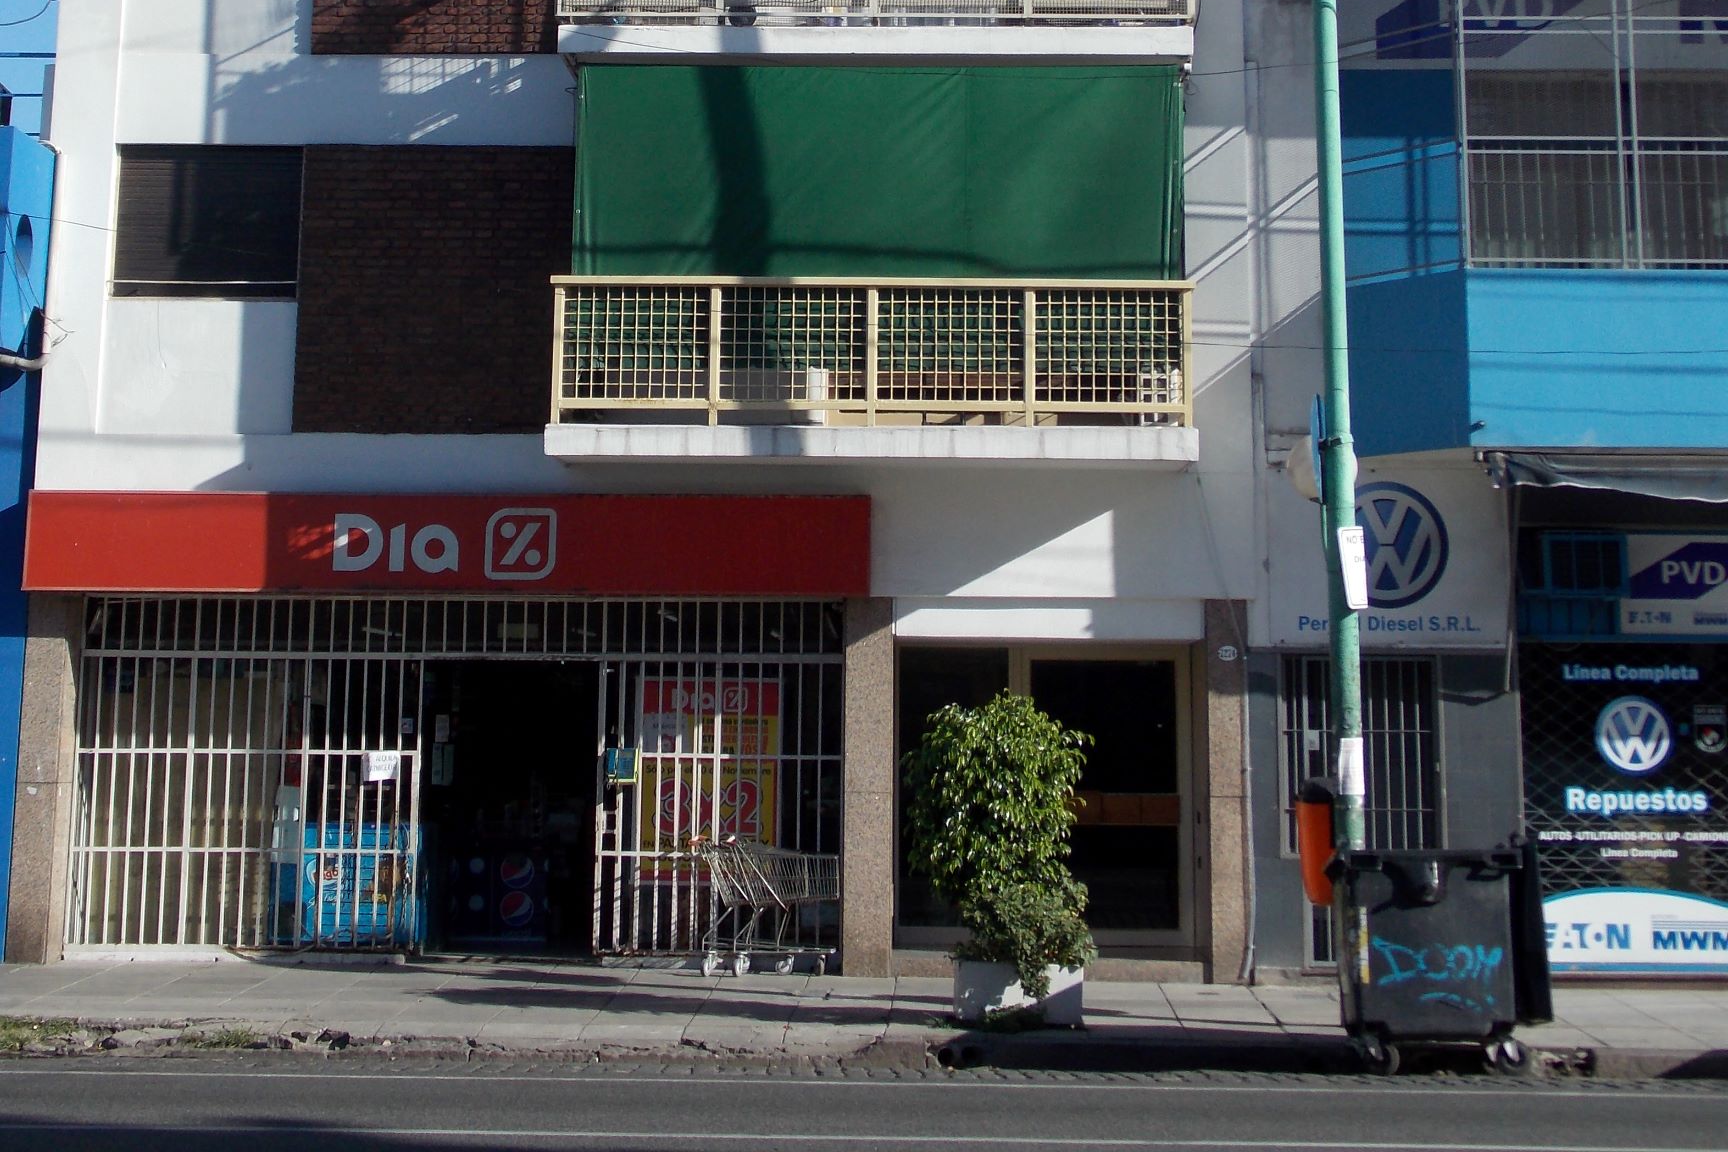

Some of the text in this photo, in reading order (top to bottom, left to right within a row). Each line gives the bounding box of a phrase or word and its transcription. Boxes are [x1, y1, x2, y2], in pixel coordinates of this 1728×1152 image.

[1661, 560, 1726, 585] PVD
[1368, 616, 1423, 631] Diesel
[1428, 616, 1480, 632] S.R.L.
[1615, 664, 1699, 683] Completa
[1566, 787, 1709, 815] Repuestos
[1538, 831, 1573, 841] AUTOS
[1630, 848, 1679, 859] Completa
